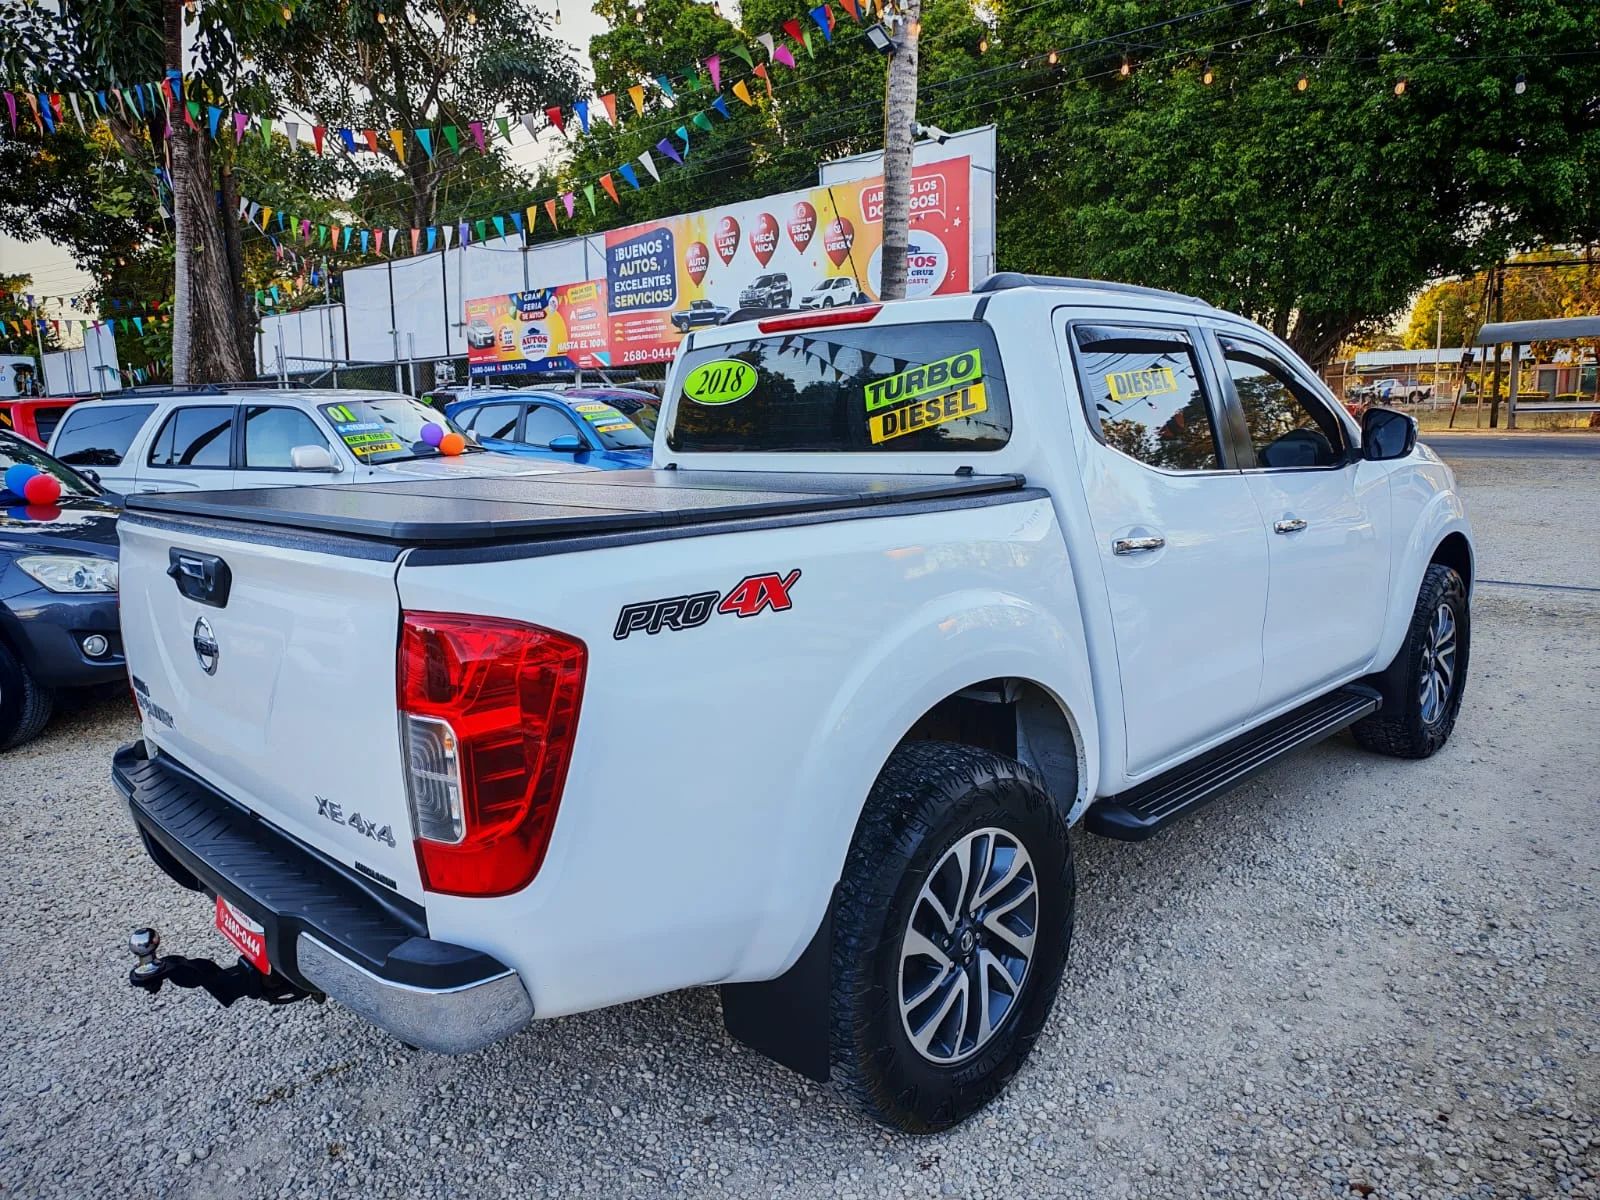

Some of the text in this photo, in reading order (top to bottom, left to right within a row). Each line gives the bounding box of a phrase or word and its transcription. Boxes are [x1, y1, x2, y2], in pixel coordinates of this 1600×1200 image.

[868, 180, 937, 203] ¡ABS LOS
[868, 194, 939, 217] DOGOS!
[791, 222, 812, 233] ESCA
[718, 236, 737, 247] LLAN
[753, 230, 775, 243] MECÁ
[794, 233, 809, 242] NEO
[615, 239, 663, 262] ¡BUENOS
[719, 246, 734, 256] TAS
[755, 243, 774, 253] NICA
[619, 257, 661, 278] AUTOS,
[688, 257, 706, 267] AUTO
[906, 255, 937, 268] TOS
[614, 274, 672, 293] EXCELENTES
[523, 292, 541, 301] GRAN
[614, 288, 673, 308] SERVICIOS!
[523, 303, 542, 312] FERIA
[529, 311, 545, 319] AUTOS
[522, 336, 548, 345] AUTOS
[557, 338, 607, 351] HASTA EL 100%
[623, 346, 677, 362] 2680-0444
[696, 365, 746, 395] 2018
[868, 353, 976, 405] TURBO
[1114, 371, 1171, 395] DIESEL
[327, 405, 357, 422] 01
[882, 388, 978, 437] DIESEL
[613, 568, 802, 640] PRO 4X
[315, 793, 345, 826] XE
[224, 913, 260, 957] 2680-0444
